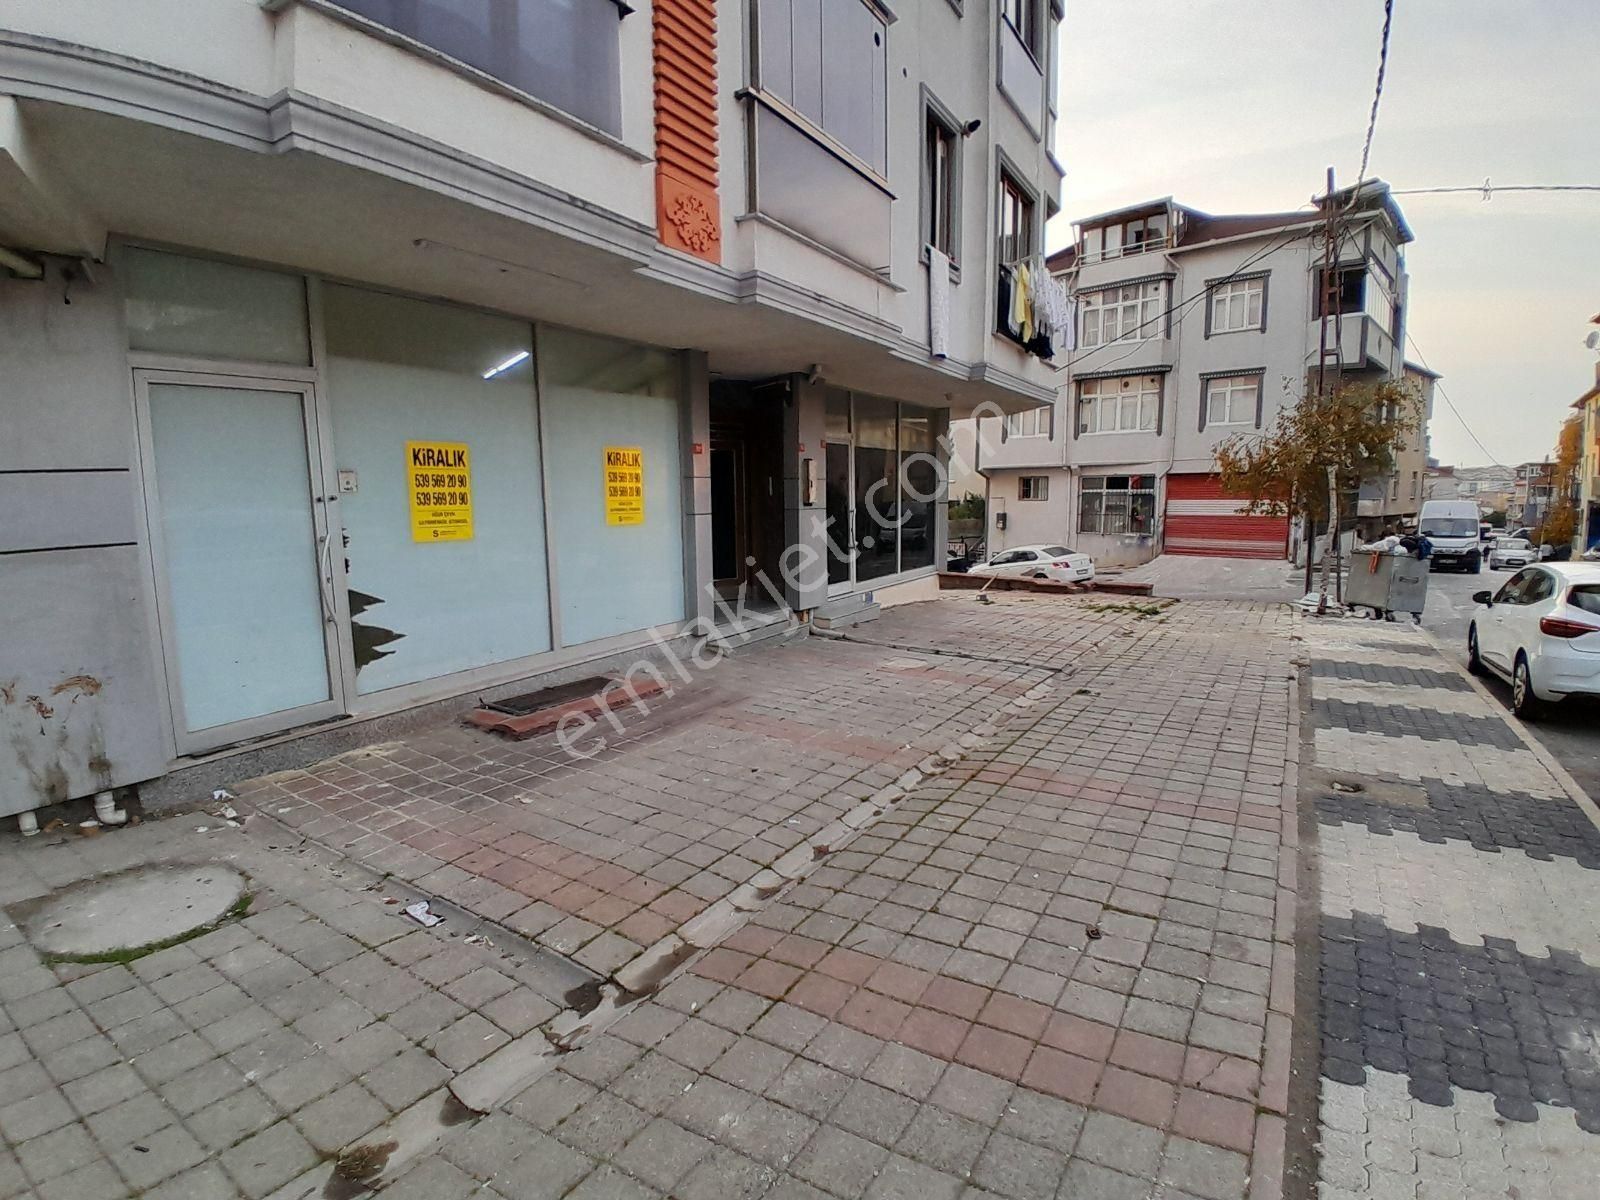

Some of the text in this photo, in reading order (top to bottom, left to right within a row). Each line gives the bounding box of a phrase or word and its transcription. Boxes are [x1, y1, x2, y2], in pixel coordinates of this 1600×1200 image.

[415, 473, 467, 488] 539 569 20 90
[416, 491, 468, 506] 539 569 20 90
